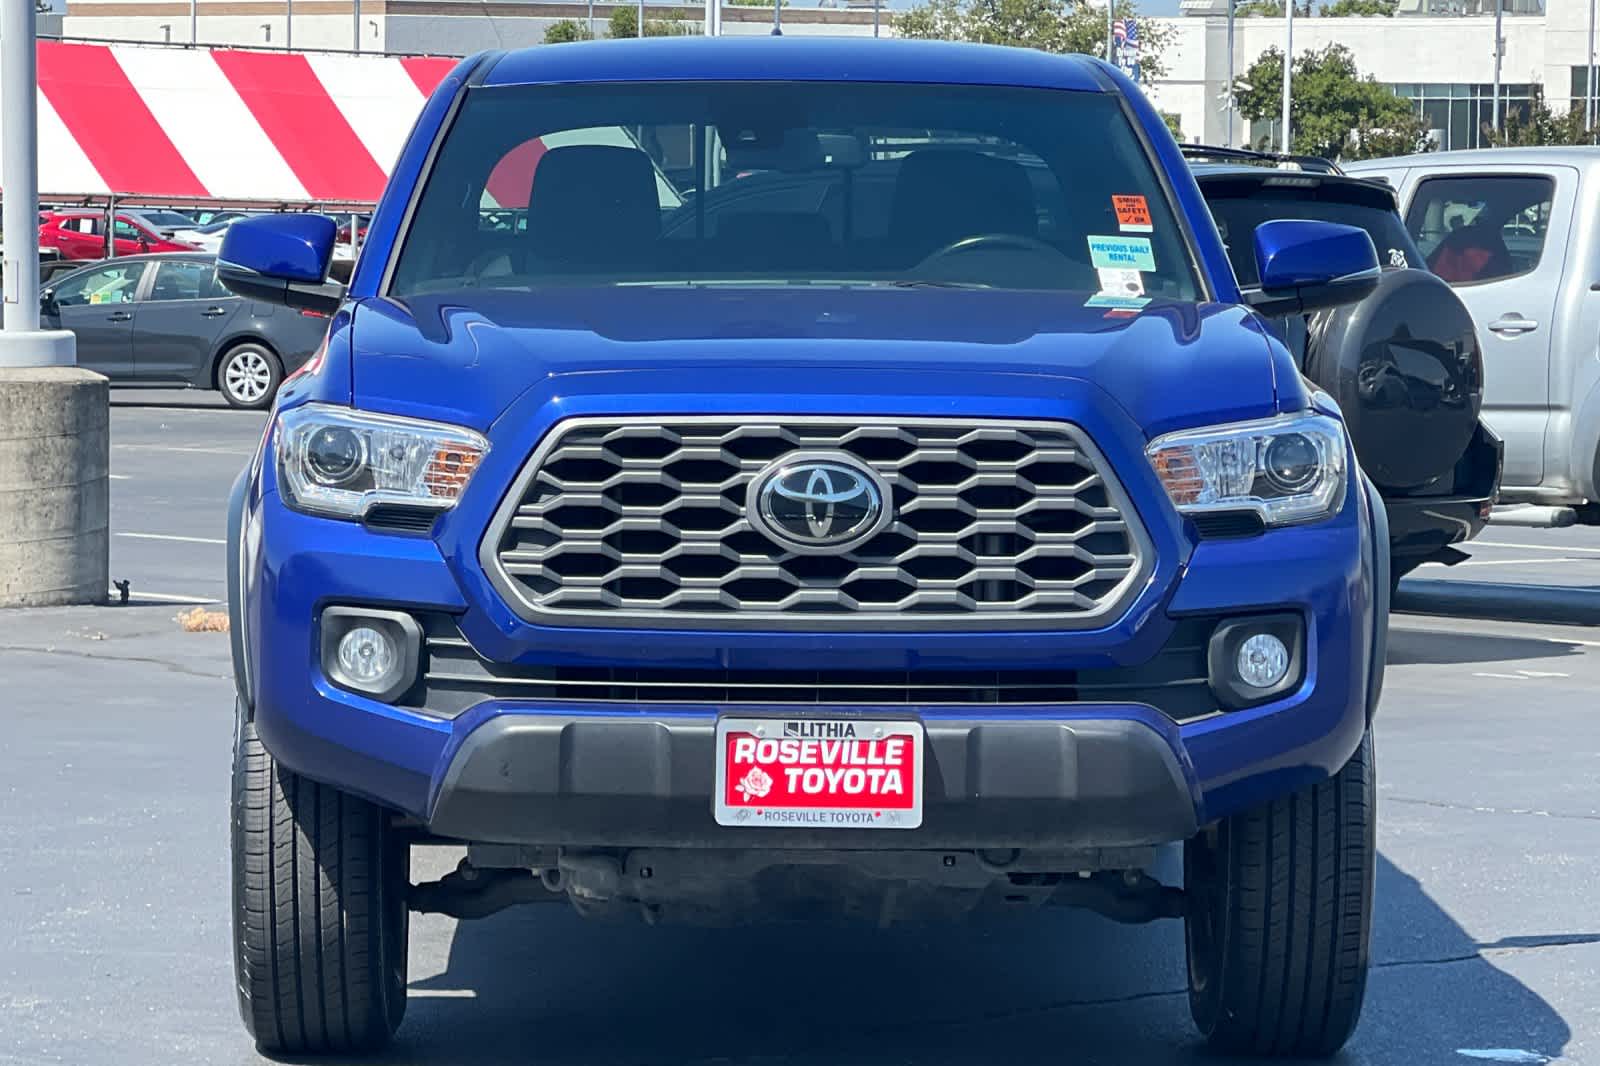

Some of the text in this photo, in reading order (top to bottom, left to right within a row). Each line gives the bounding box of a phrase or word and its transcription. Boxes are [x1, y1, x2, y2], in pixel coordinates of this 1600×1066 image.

[1091, 243, 1150, 254] PREVIOUS DAILY
[1108, 253, 1137, 262] RENTAL
[801, 722, 856, 738] LITHIA
[734, 738, 905, 765] ROSEVILLE
[784, 767, 904, 794] TOYOTA
[764, 811, 874, 823] ROSEVILLE TOYOTA
